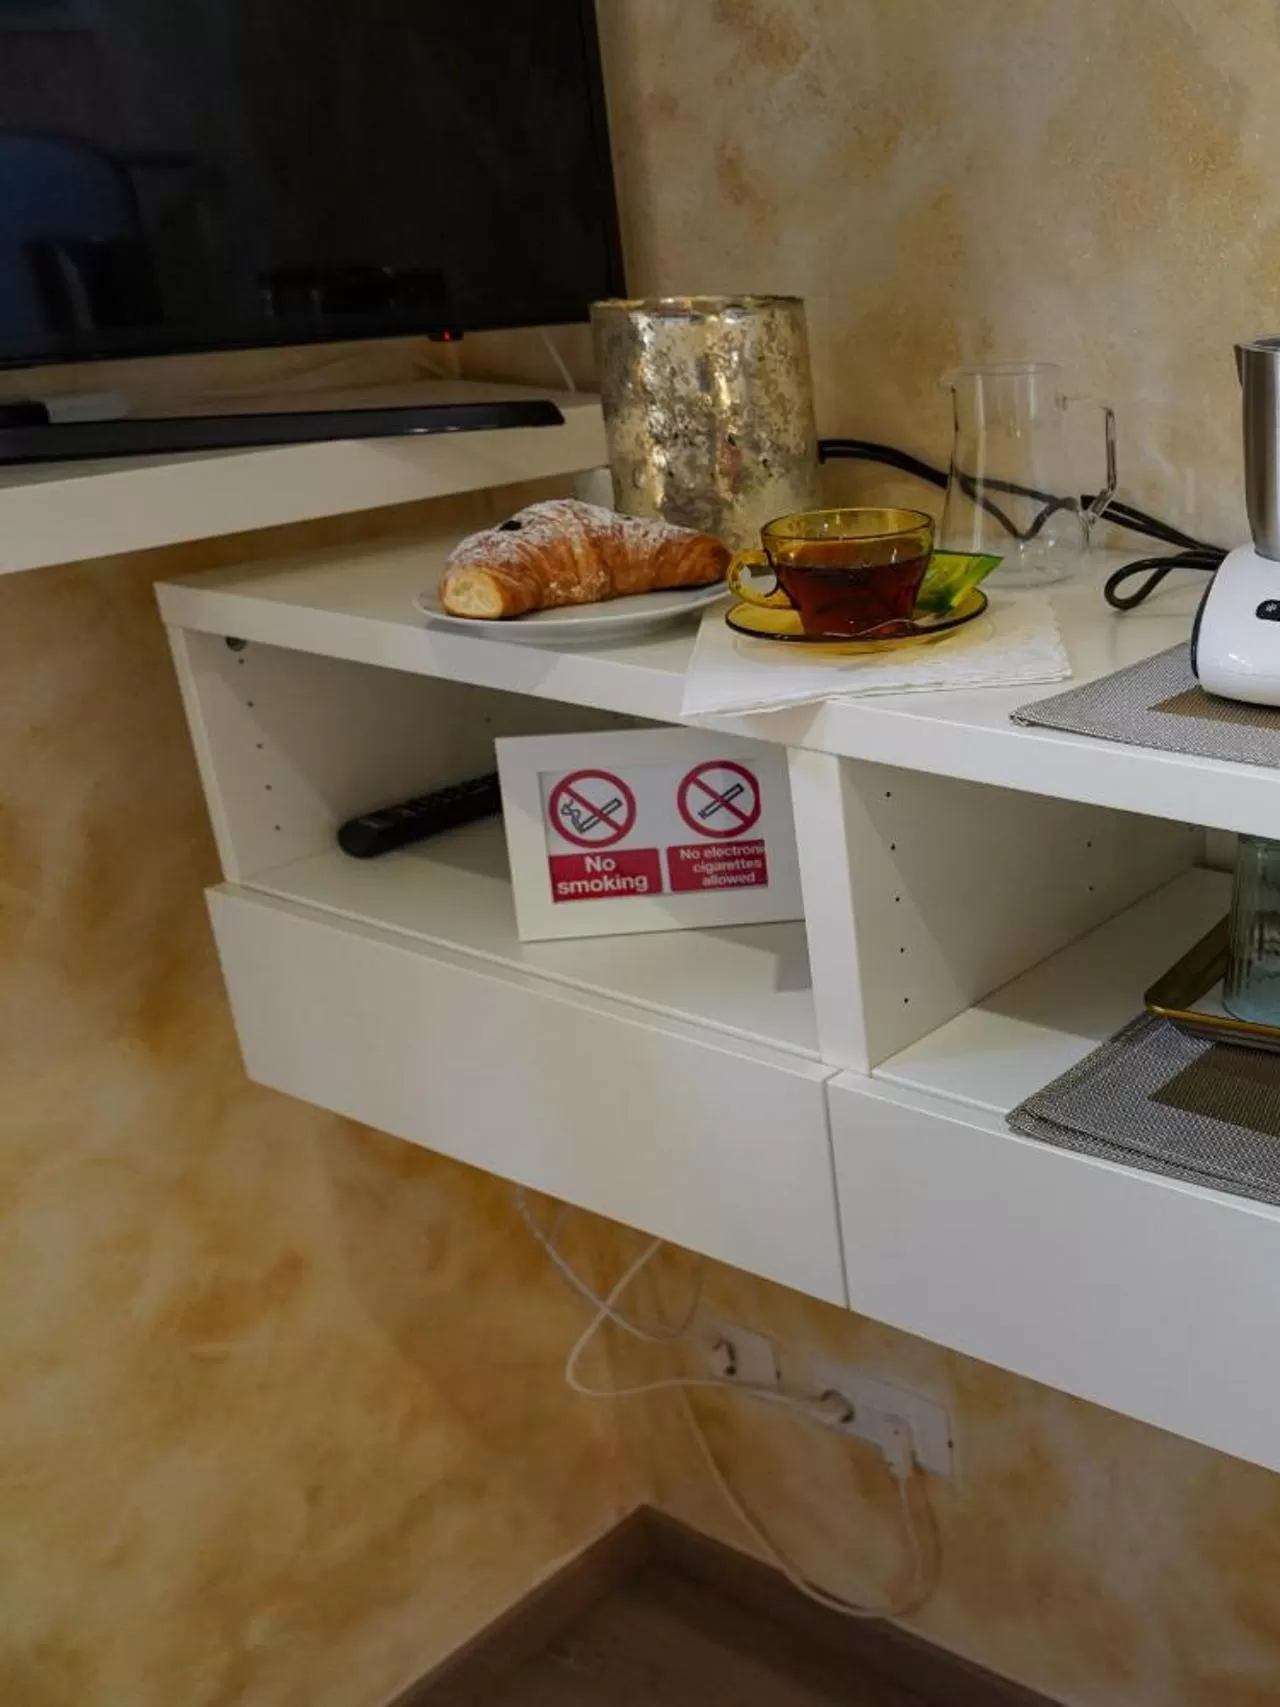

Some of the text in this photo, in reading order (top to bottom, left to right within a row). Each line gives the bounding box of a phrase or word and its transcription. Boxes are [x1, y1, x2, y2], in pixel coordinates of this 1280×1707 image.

[679, 847, 699, 860] No
[584, 855, 616, 872] No
[693, 858, 762, 874] cigarettes
[557, 875, 648, 895] smoking
[702, 872, 756, 886] allowed
